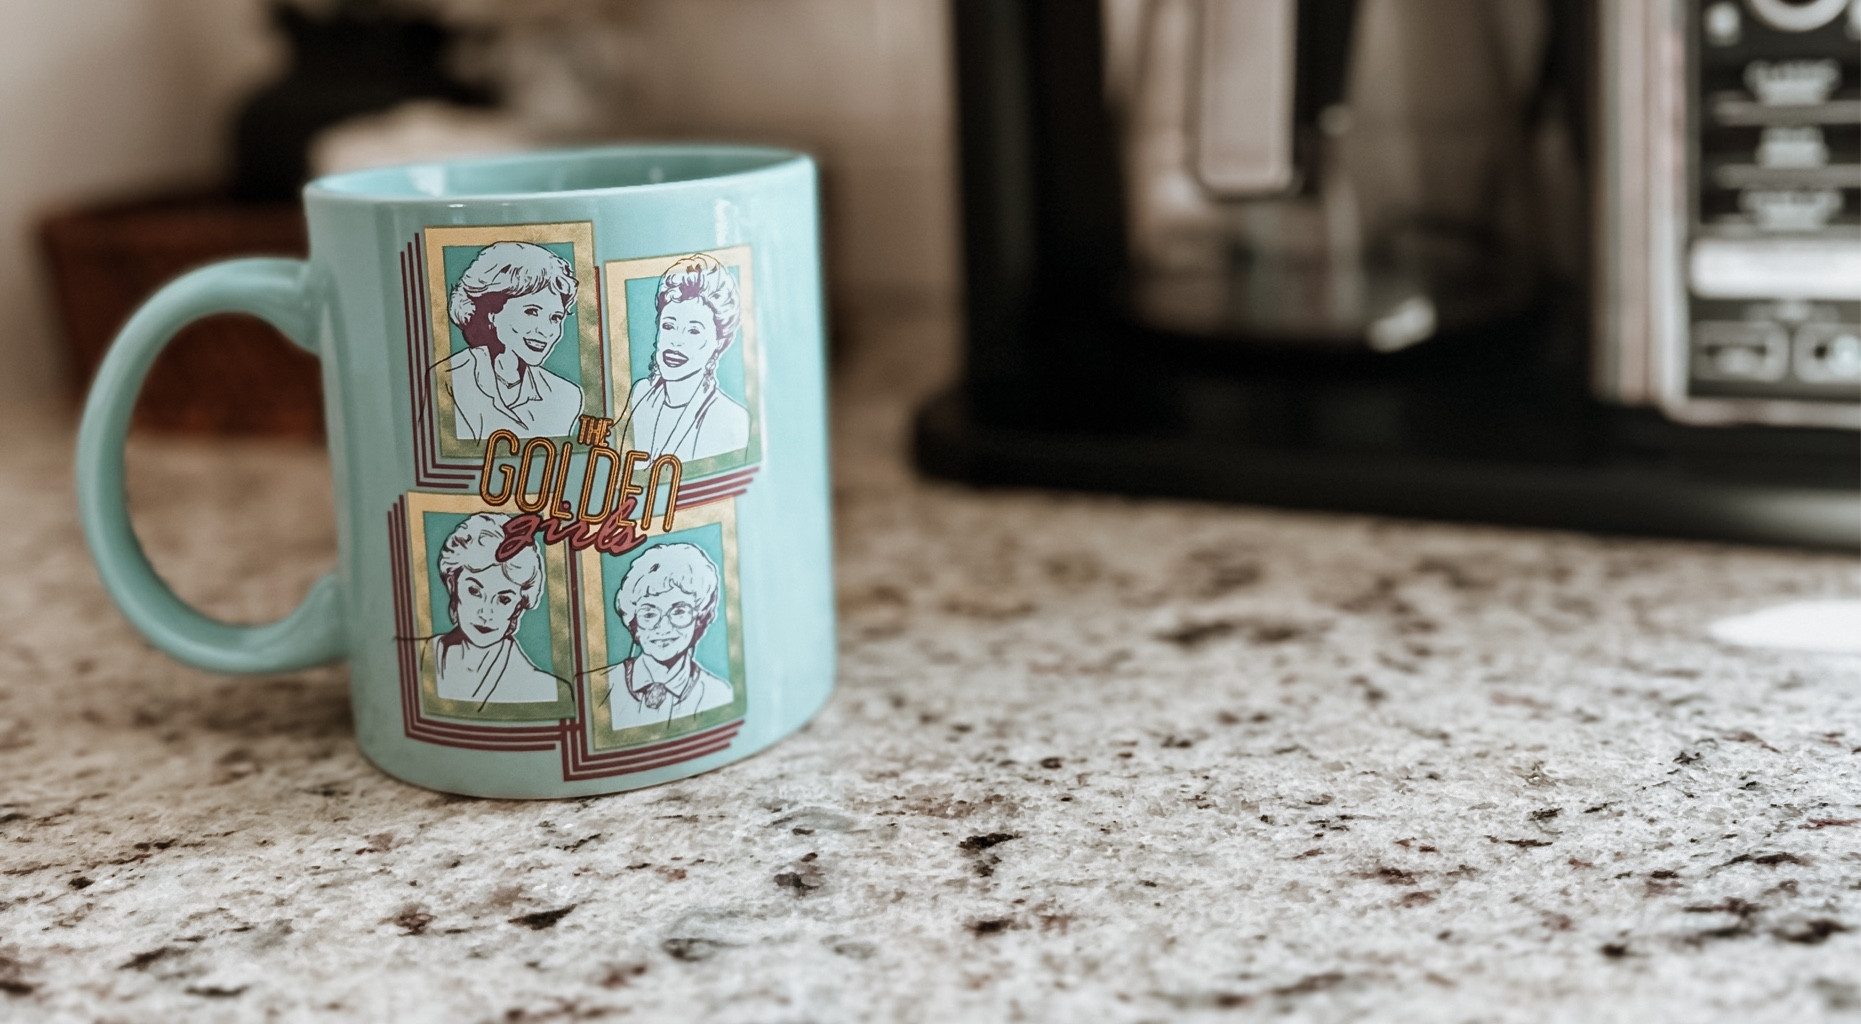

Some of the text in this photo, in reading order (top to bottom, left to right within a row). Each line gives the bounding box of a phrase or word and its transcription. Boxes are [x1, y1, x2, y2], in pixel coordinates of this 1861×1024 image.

[578, 415, 614, 448] THE
[480, 429, 682, 532] GOLDEN
[495, 497, 647, 562] girls
